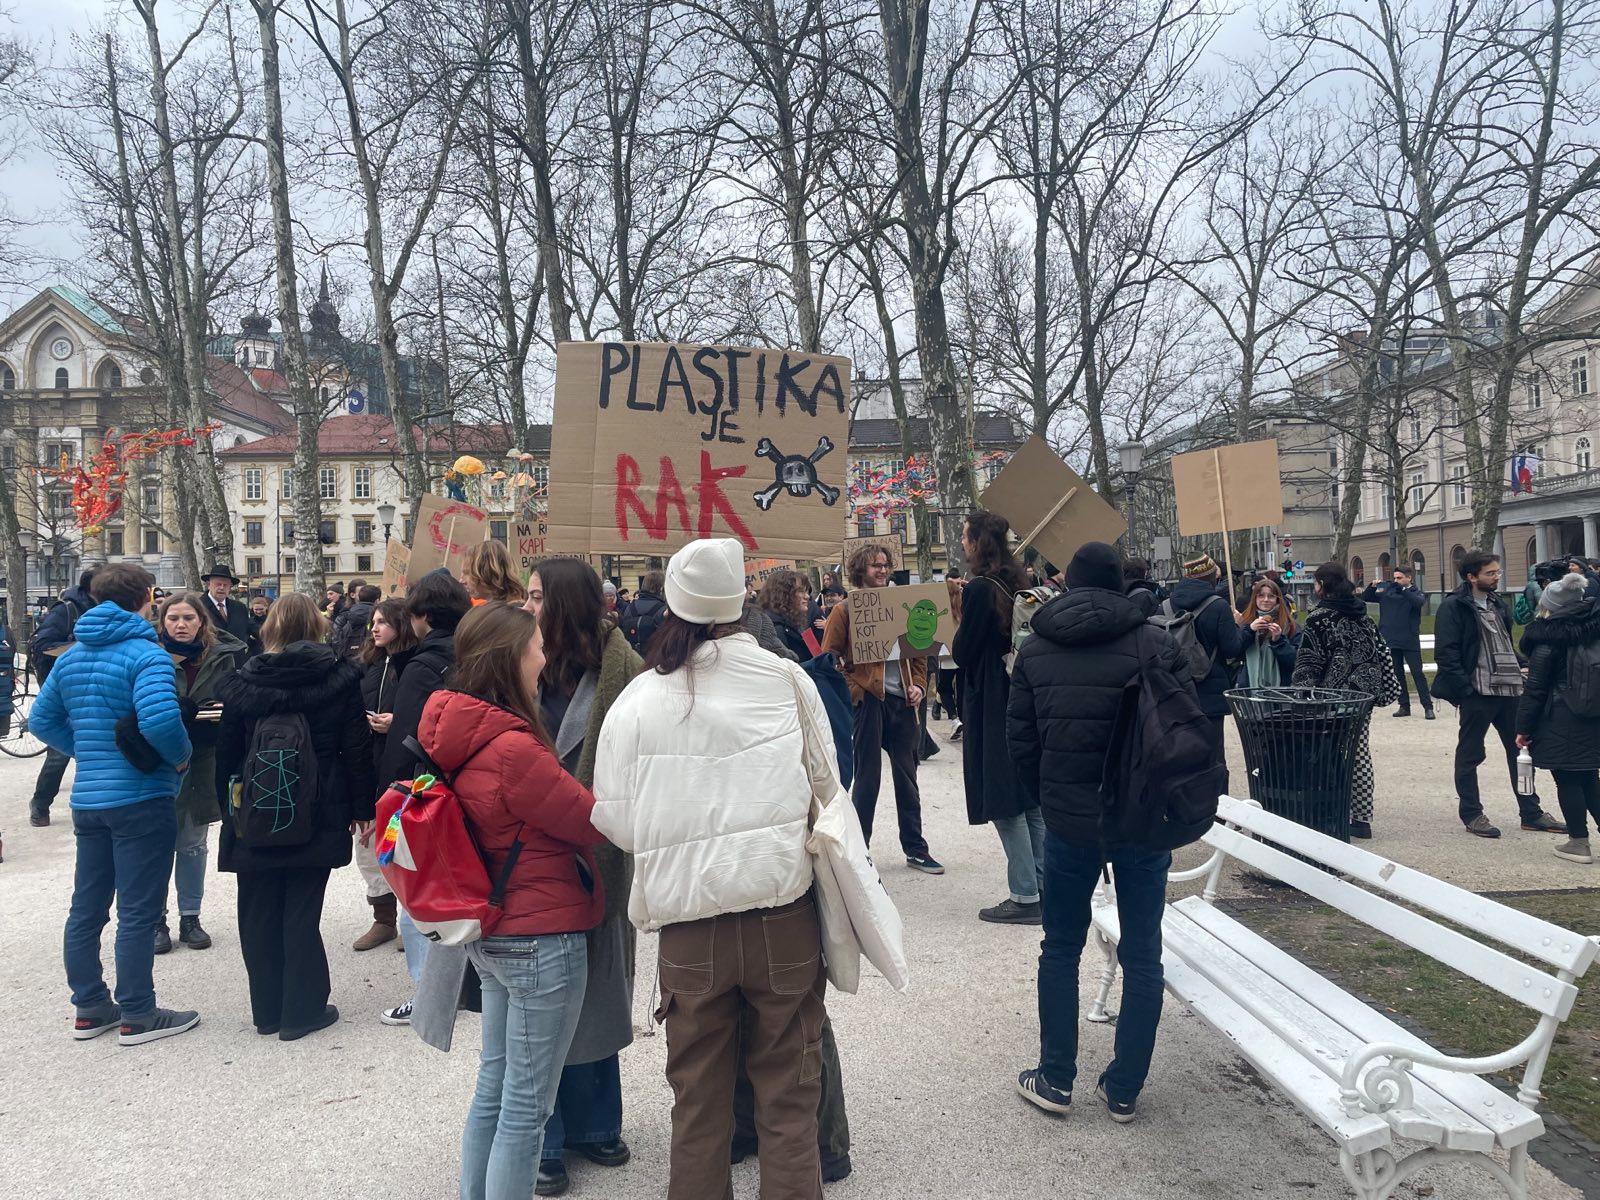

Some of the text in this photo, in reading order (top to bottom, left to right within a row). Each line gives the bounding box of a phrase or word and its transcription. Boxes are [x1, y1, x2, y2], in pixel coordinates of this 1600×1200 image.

[599, 343, 845, 418] PLASTIKA
[701, 410, 745, 443] JE
[615, 450, 760, 551] RAK
[517, 523, 548, 537] NA R
[519, 537, 547, 555] KAPI
[852, 591, 881, 609] BODI
[854, 606, 894, 625] ZELEN
[856, 625, 876, 639] KOT
[854, 640, 891, 663] SHREK
